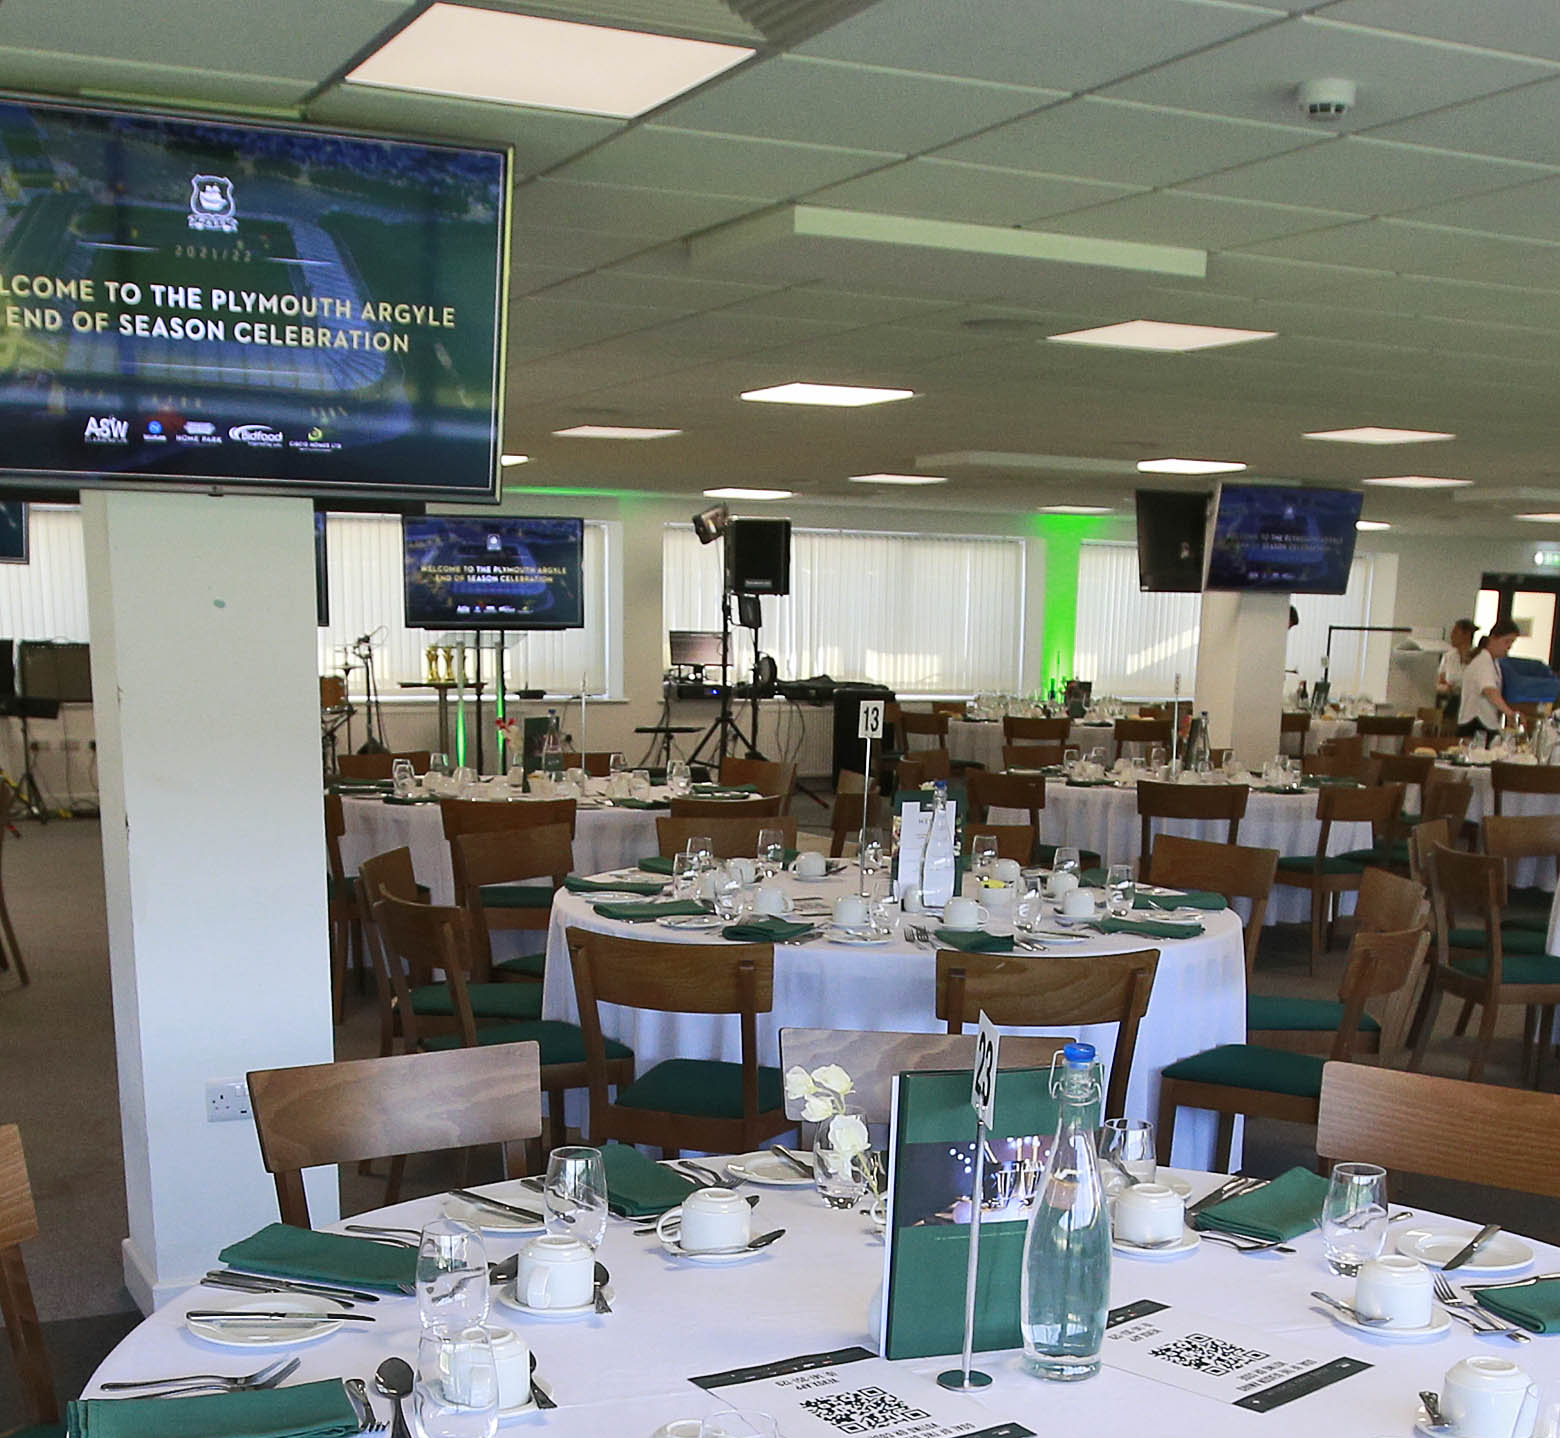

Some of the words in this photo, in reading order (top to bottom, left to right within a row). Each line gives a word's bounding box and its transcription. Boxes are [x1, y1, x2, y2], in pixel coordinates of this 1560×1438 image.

[104, 280, 142, 305] TO
[150, 284, 203, 310] THE
[211, 288, 352, 320] PLYMOUTH
[361, 301, 456, 328] ARGYLE
[6, 305, 63, 331] END
[72, 310, 109, 333] OF
[118, 313, 226, 342] SEASON
[233, 322, 409, 353] CELEBRATION
[84, 416, 129, 438] ASW
[463, 565, 474, 573] TO
[475, 565, 491, 574] THE
[466, 574, 499, 582] SEASON
[864, 706, 880, 732] 13
[976, 1031, 993, 1107] 23
